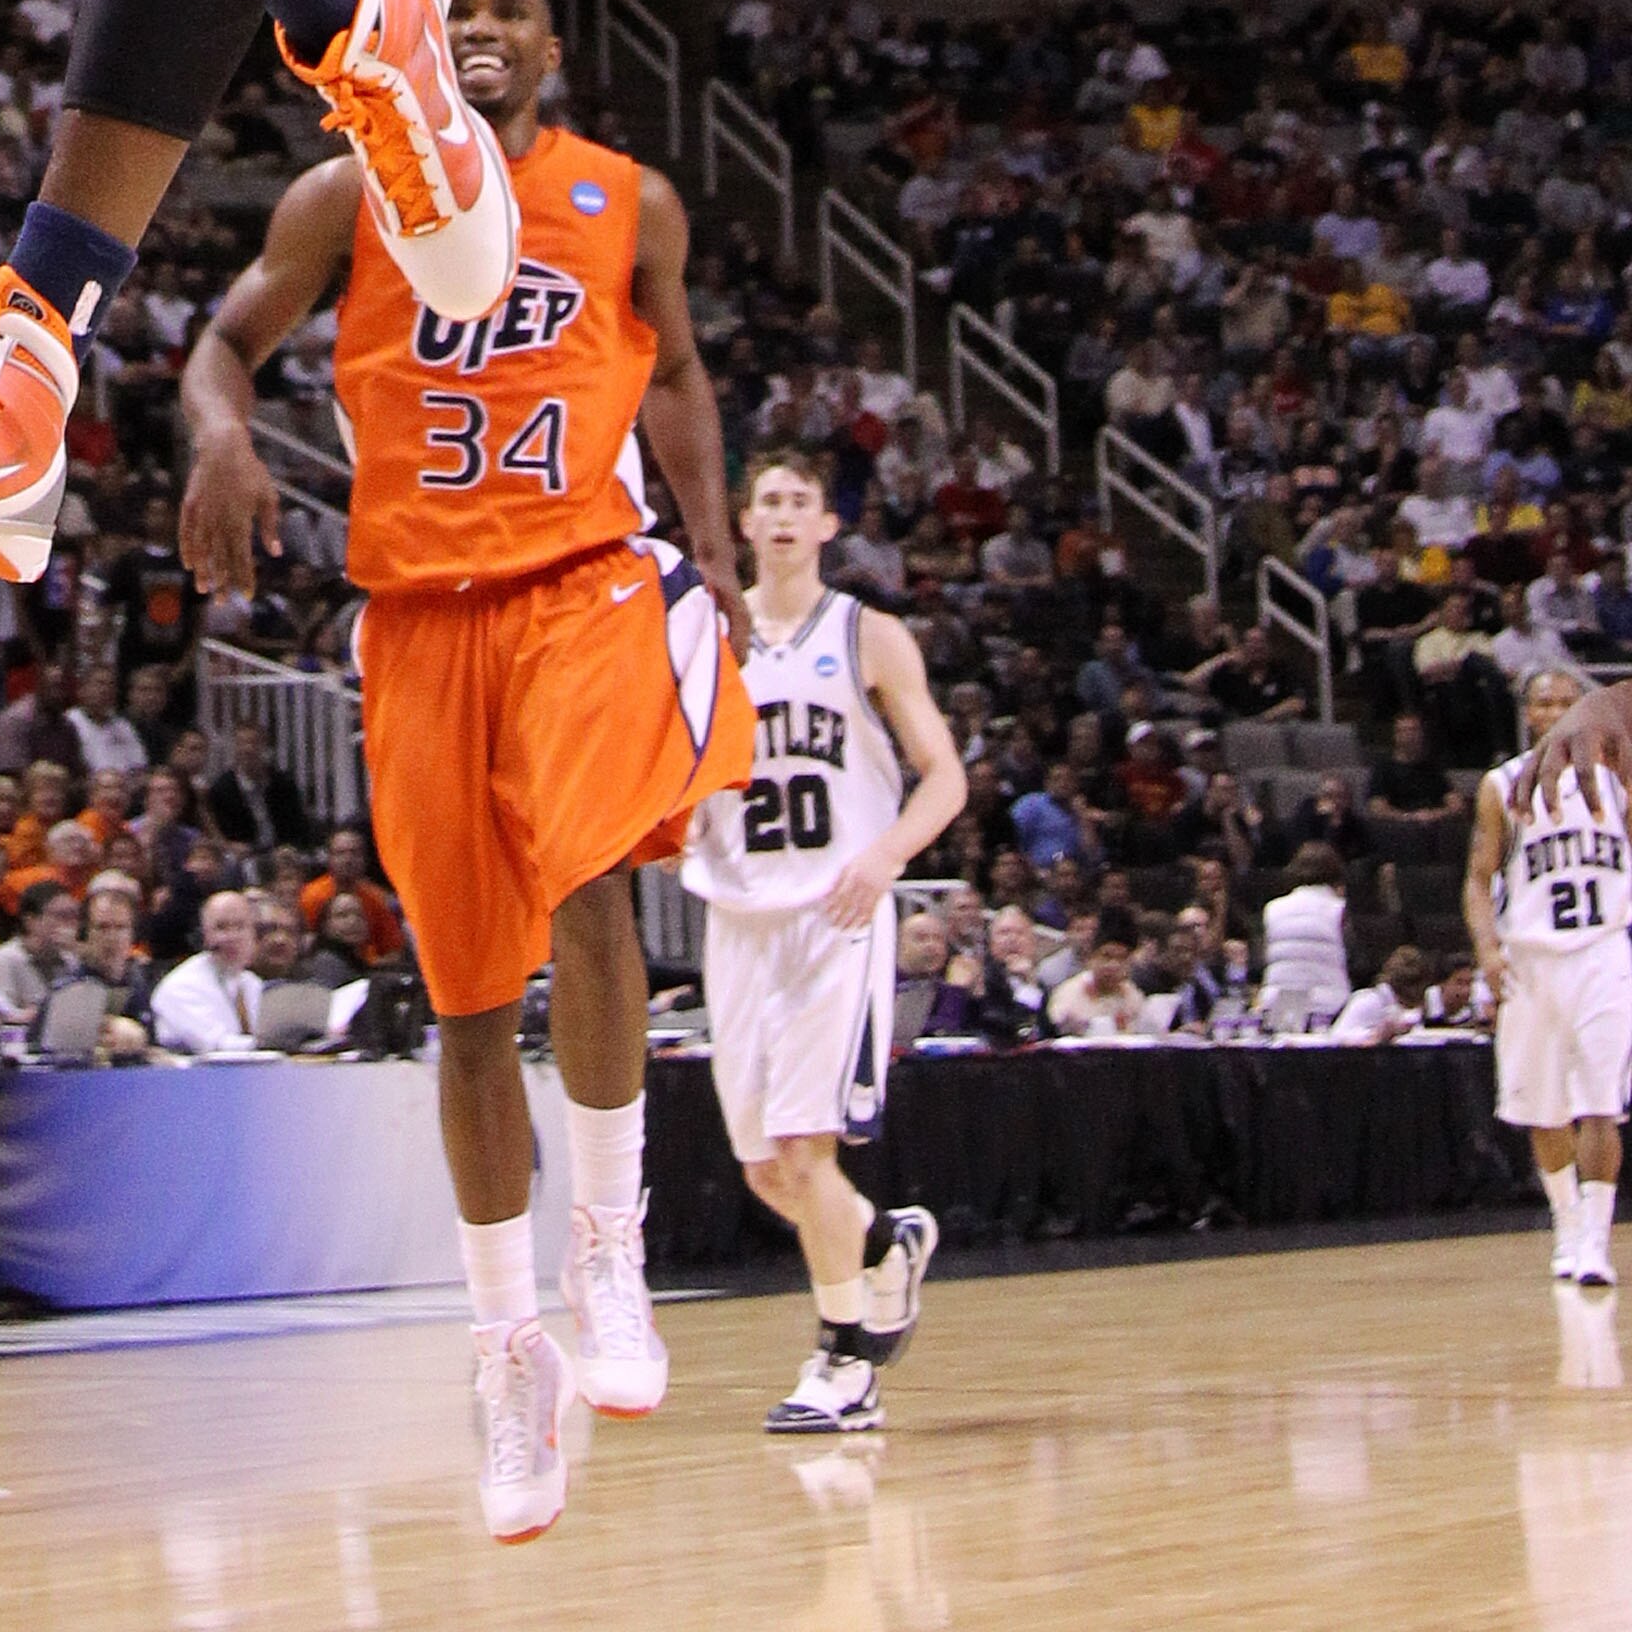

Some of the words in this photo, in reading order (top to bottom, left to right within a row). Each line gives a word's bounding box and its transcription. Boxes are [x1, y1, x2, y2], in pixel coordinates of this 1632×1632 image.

[419, 390, 568, 496] 34
[756, 701, 845, 769] TLER
[743, 774, 832, 853] 20
[1525, 829, 1624, 882] BUTLER
[1551, 880, 1603, 930] 21
